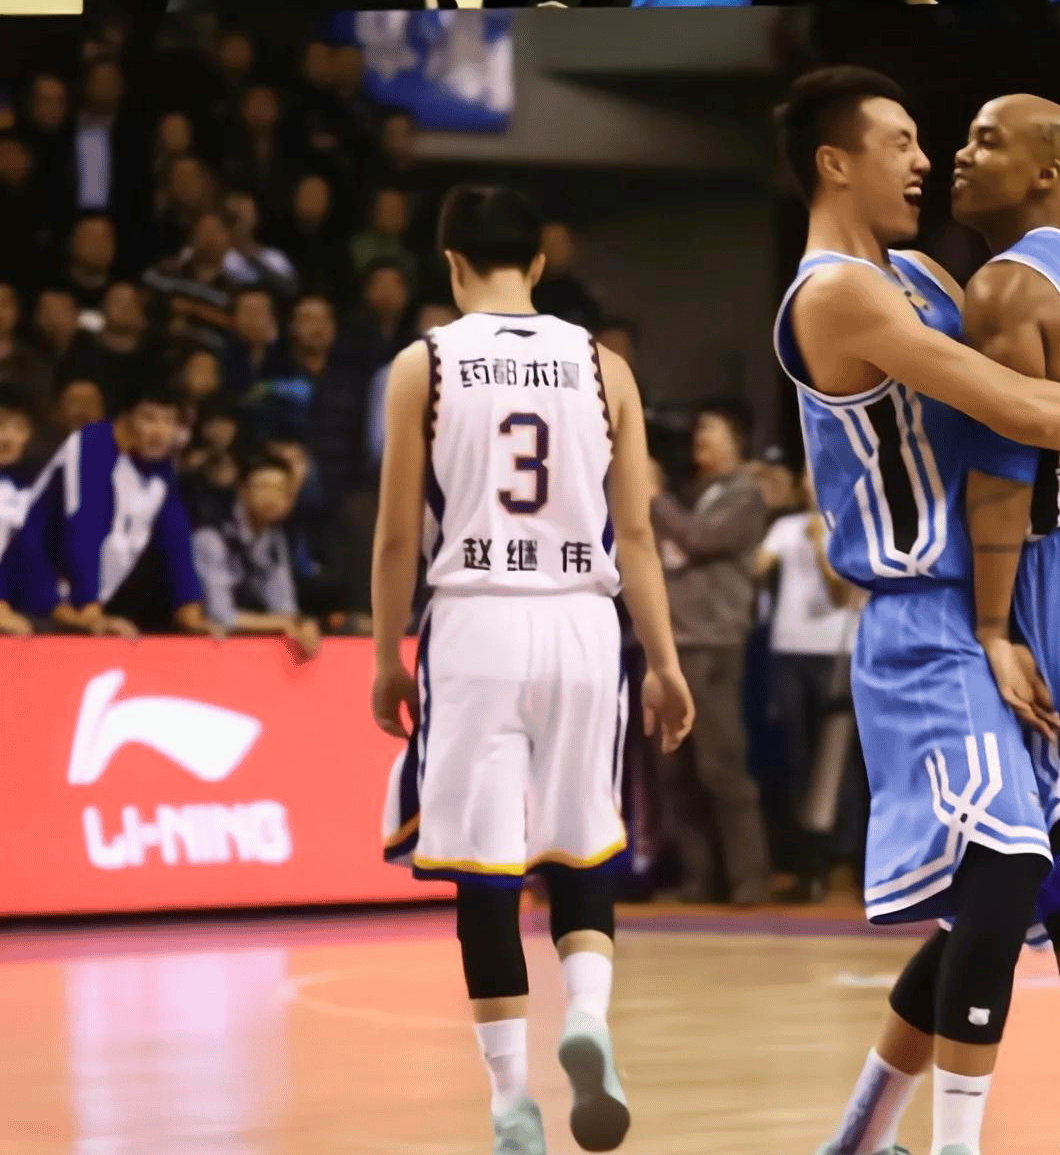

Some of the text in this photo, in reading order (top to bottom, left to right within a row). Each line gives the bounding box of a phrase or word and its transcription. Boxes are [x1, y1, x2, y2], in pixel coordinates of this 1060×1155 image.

[498, 412, 550, 515] 3
[462, 538, 593, 573] 赵继伟
[82, 801, 291, 869] LI-NING
